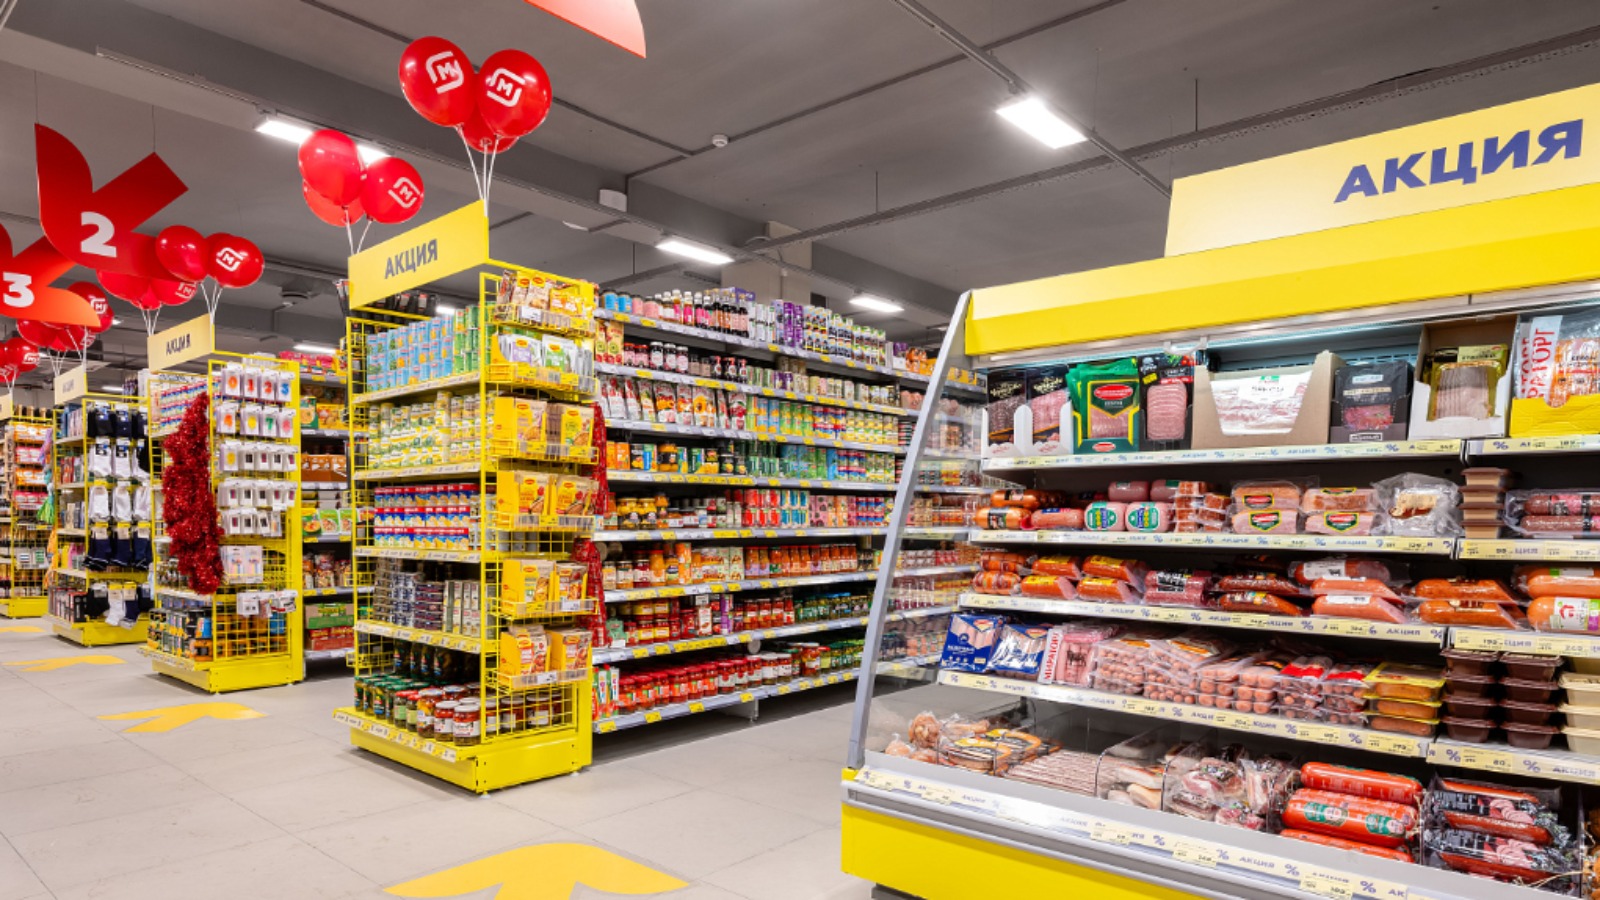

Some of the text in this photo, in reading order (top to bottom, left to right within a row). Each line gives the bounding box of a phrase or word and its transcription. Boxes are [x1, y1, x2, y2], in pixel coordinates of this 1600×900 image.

[1333, 118, 1584, 204] АКЦИЯ
[80, 211, 117, 258] 2
[384, 238, 438, 280] АКЦИЯ
[2, 271, 35, 308] 3
[165, 333, 191, 355] АКЦИЯ
[265, 416, 274, 431] 7
